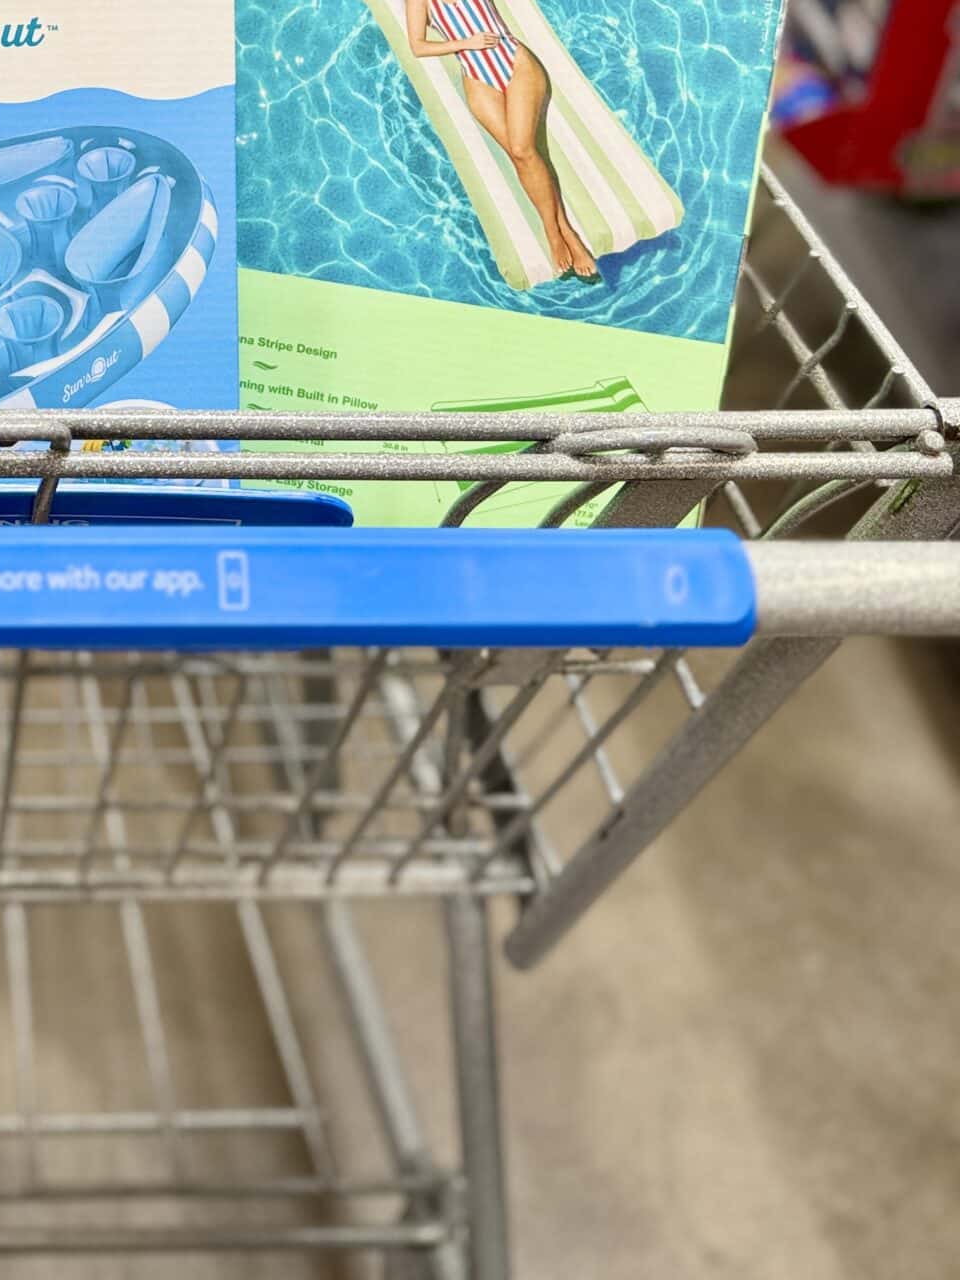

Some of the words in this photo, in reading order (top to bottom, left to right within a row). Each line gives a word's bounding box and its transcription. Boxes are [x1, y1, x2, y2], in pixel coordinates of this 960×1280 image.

[257, 336, 293, 352] Stripe
[296, 343, 338, 359] Design
[239, 379, 265, 394] ning
[268, 383, 294, 397] with
[296, 388, 325, 402] Built
[327, 392, 339, 405] in
[341, 395, 379, 410] Pillow
[306, 479, 354, 497] Storage
[47, 564, 101, 591] with
[105, 569, 148, 590] our
[151, 569, 205, 597] app.
